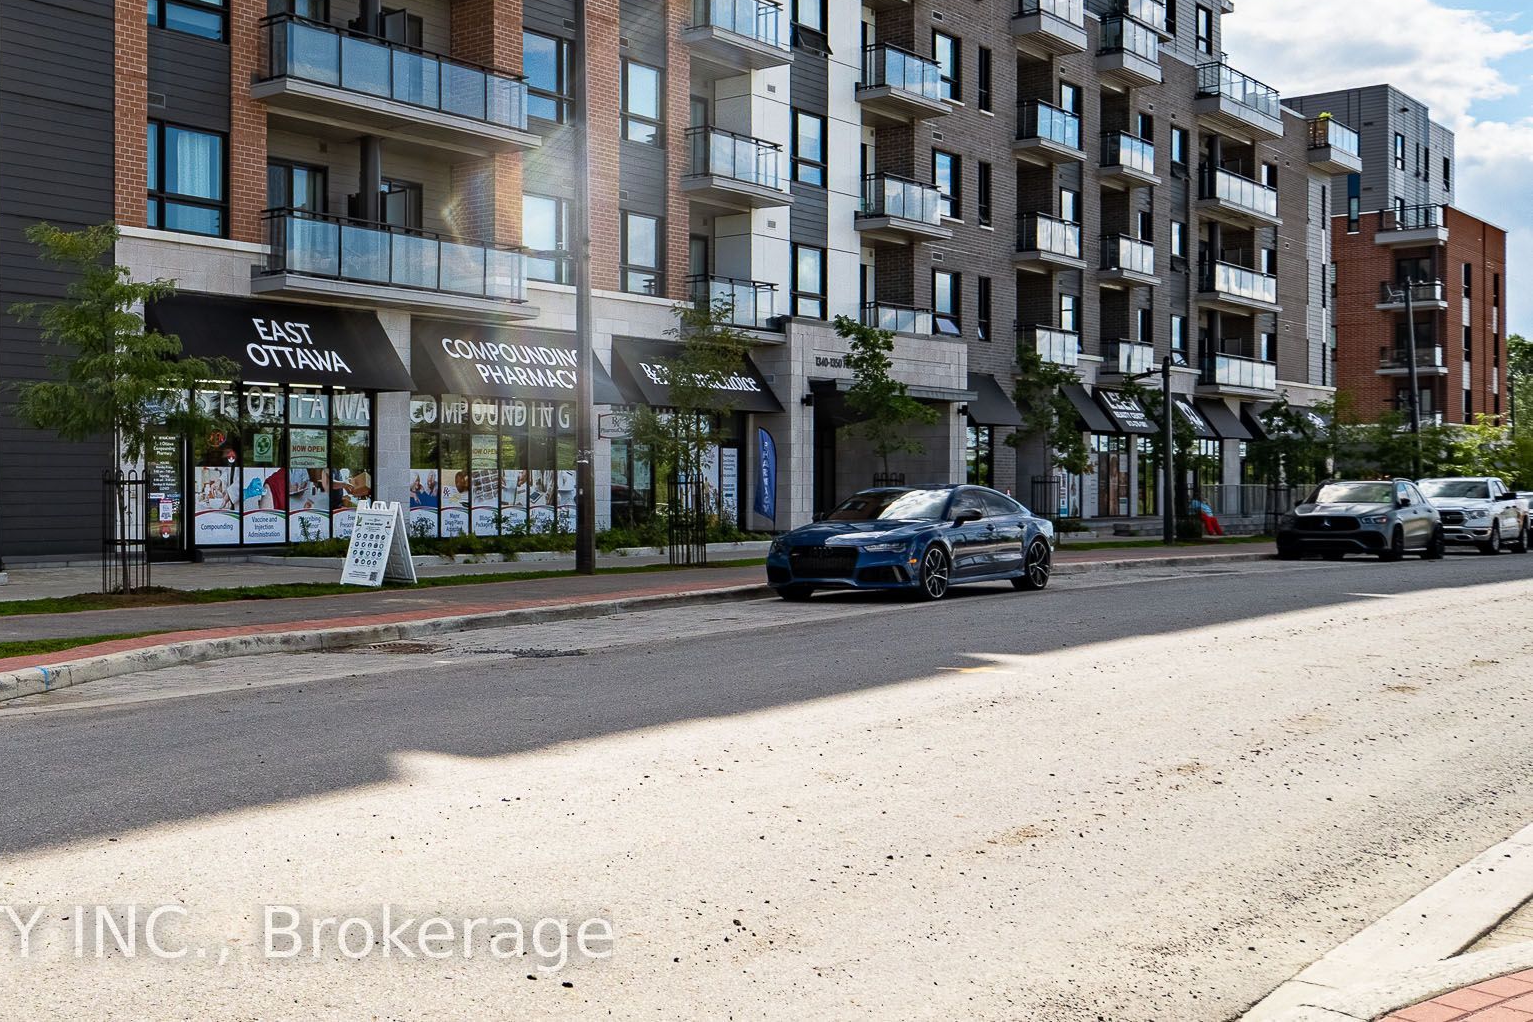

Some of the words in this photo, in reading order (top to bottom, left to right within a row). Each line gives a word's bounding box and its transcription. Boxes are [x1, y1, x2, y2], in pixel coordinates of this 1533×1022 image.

[252, 318, 313, 345] EAST
[246, 343, 352, 374] OTTAWA
[475, 363, 577, 389] PHARMACY
[410, 394, 571, 429] COMPOUNDING
[200, 523, 234, 531] Compounding
[254, 524, 274, 532] Injection
